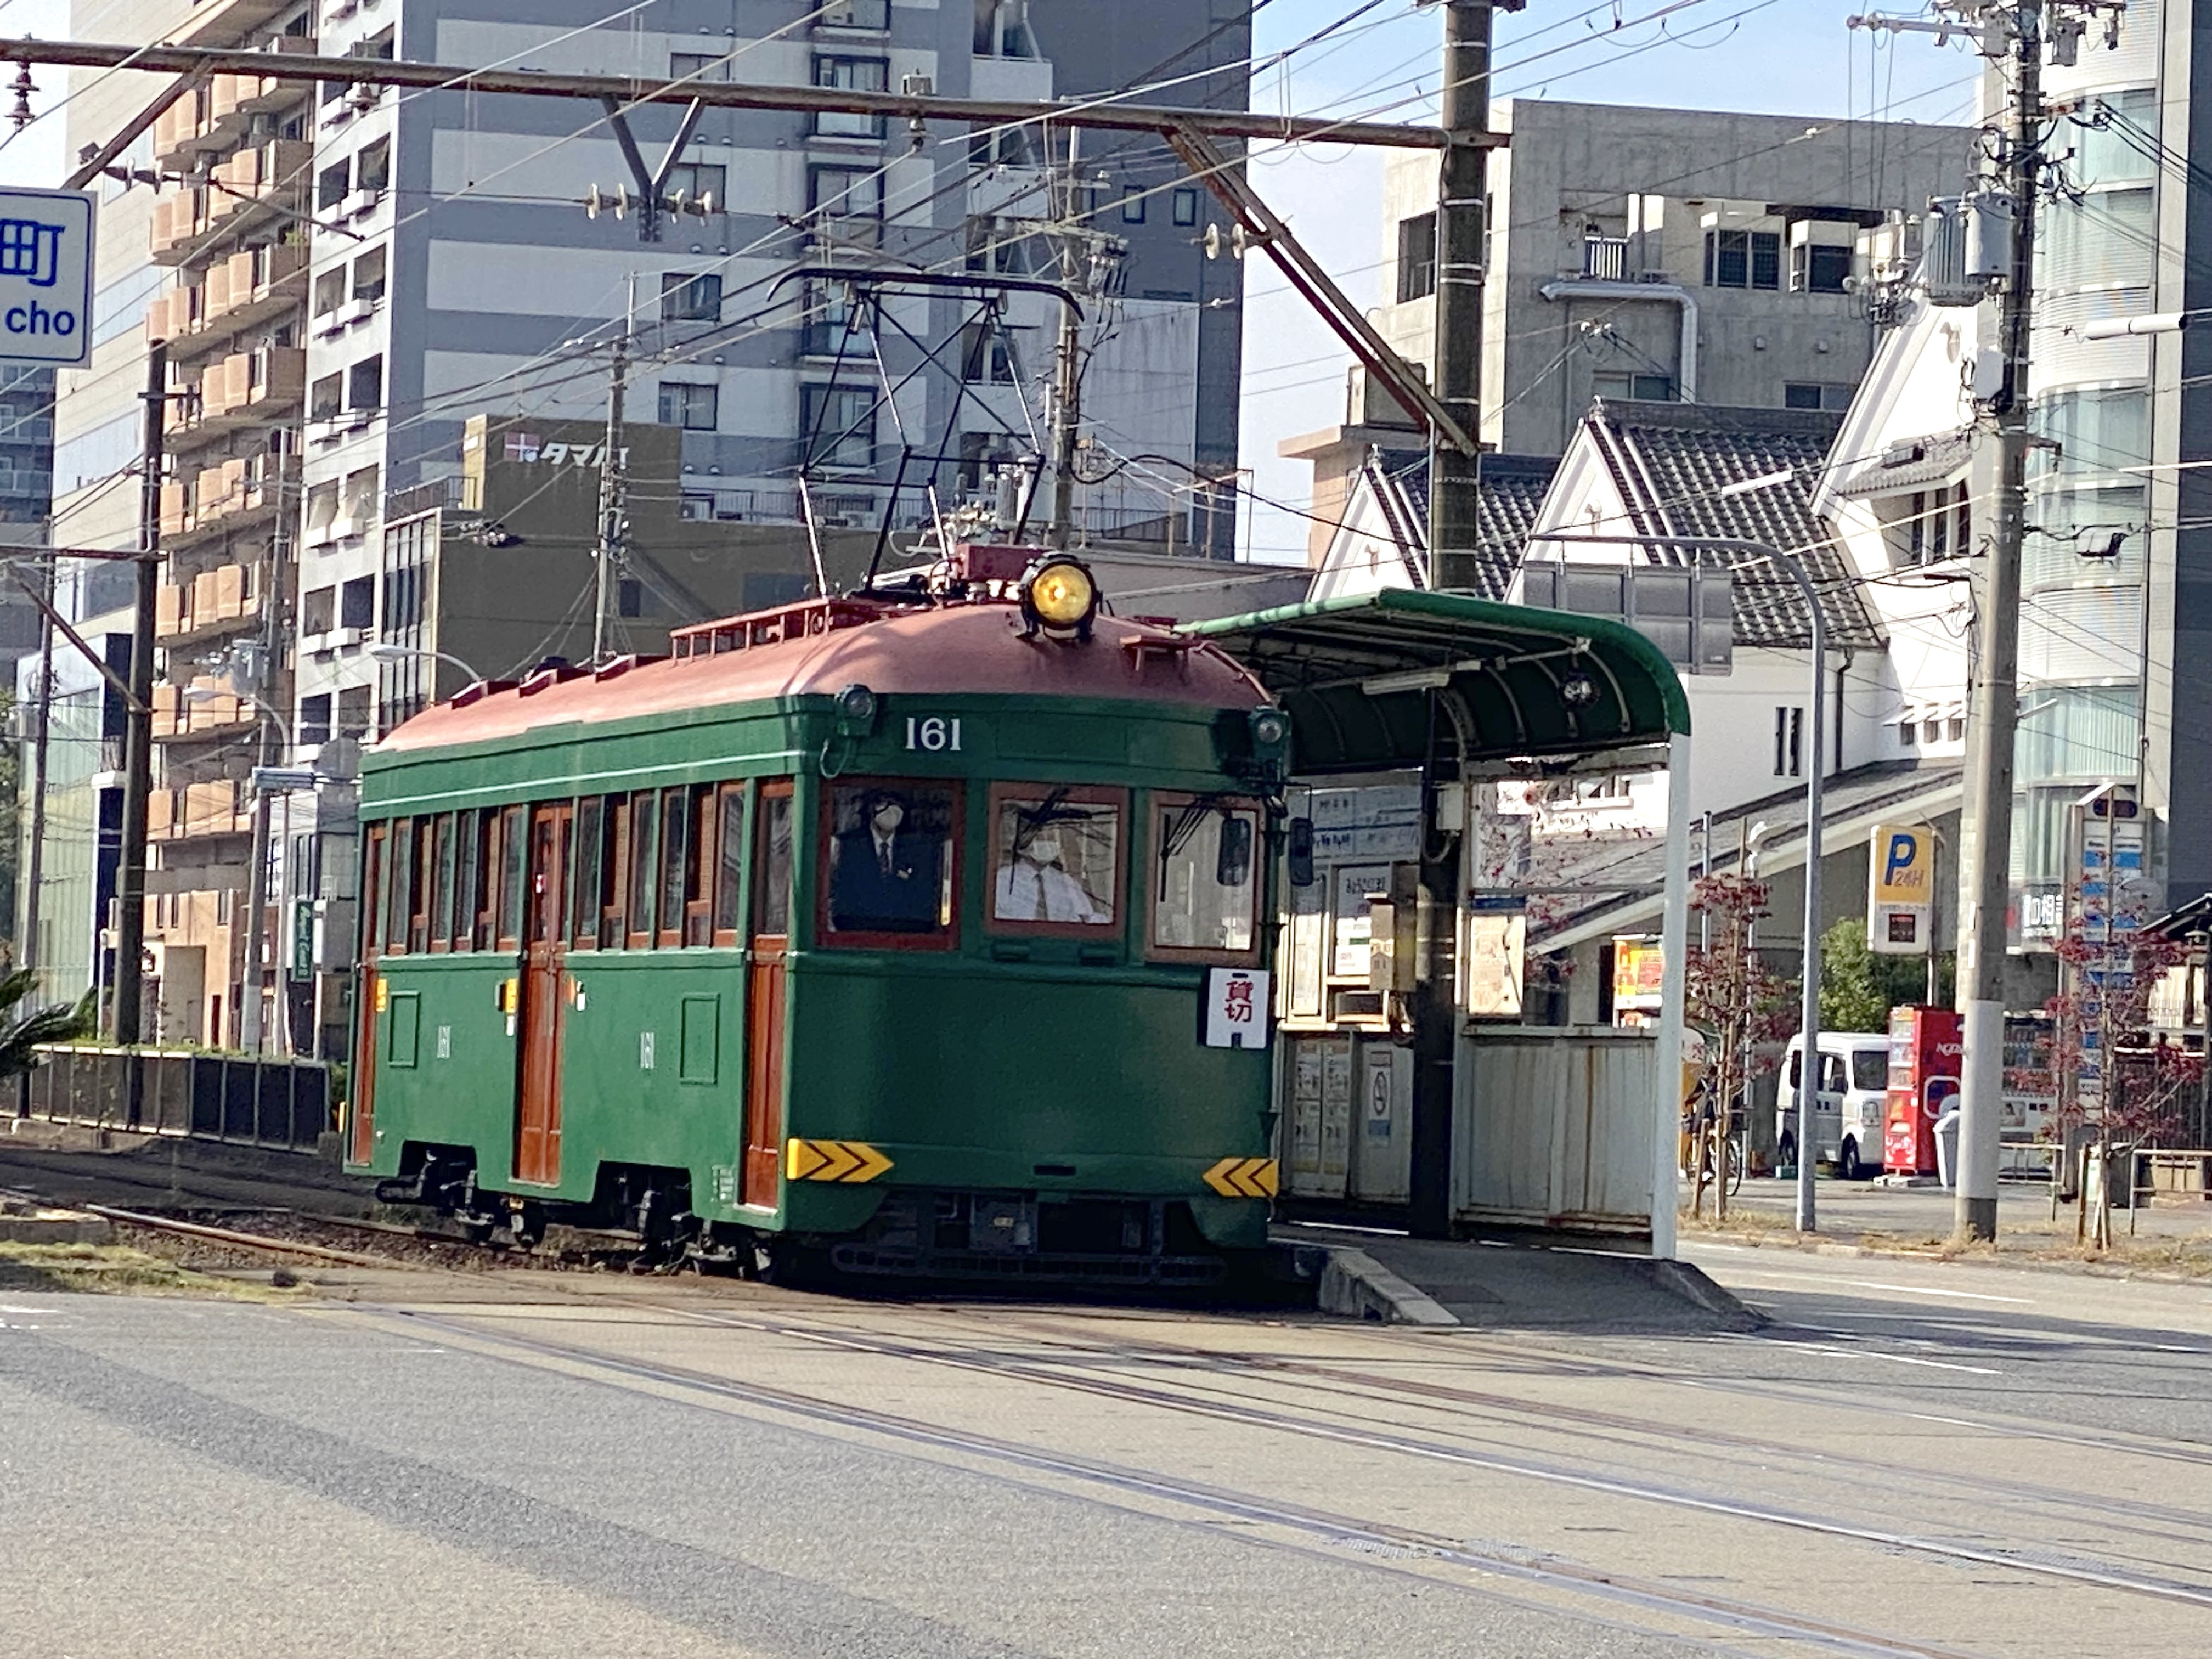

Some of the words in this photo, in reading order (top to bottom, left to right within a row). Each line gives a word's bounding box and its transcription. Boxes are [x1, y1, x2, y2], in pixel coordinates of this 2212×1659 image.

[0, 219, 65, 286] 町
[5, 301, 75, 336] cho
[906, 718, 961, 751] 161
[1884, 834, 1917, 885] P
[1894, 869, 1925, 887] 24H
[1224, 981, 1254, 1023] 貸切
